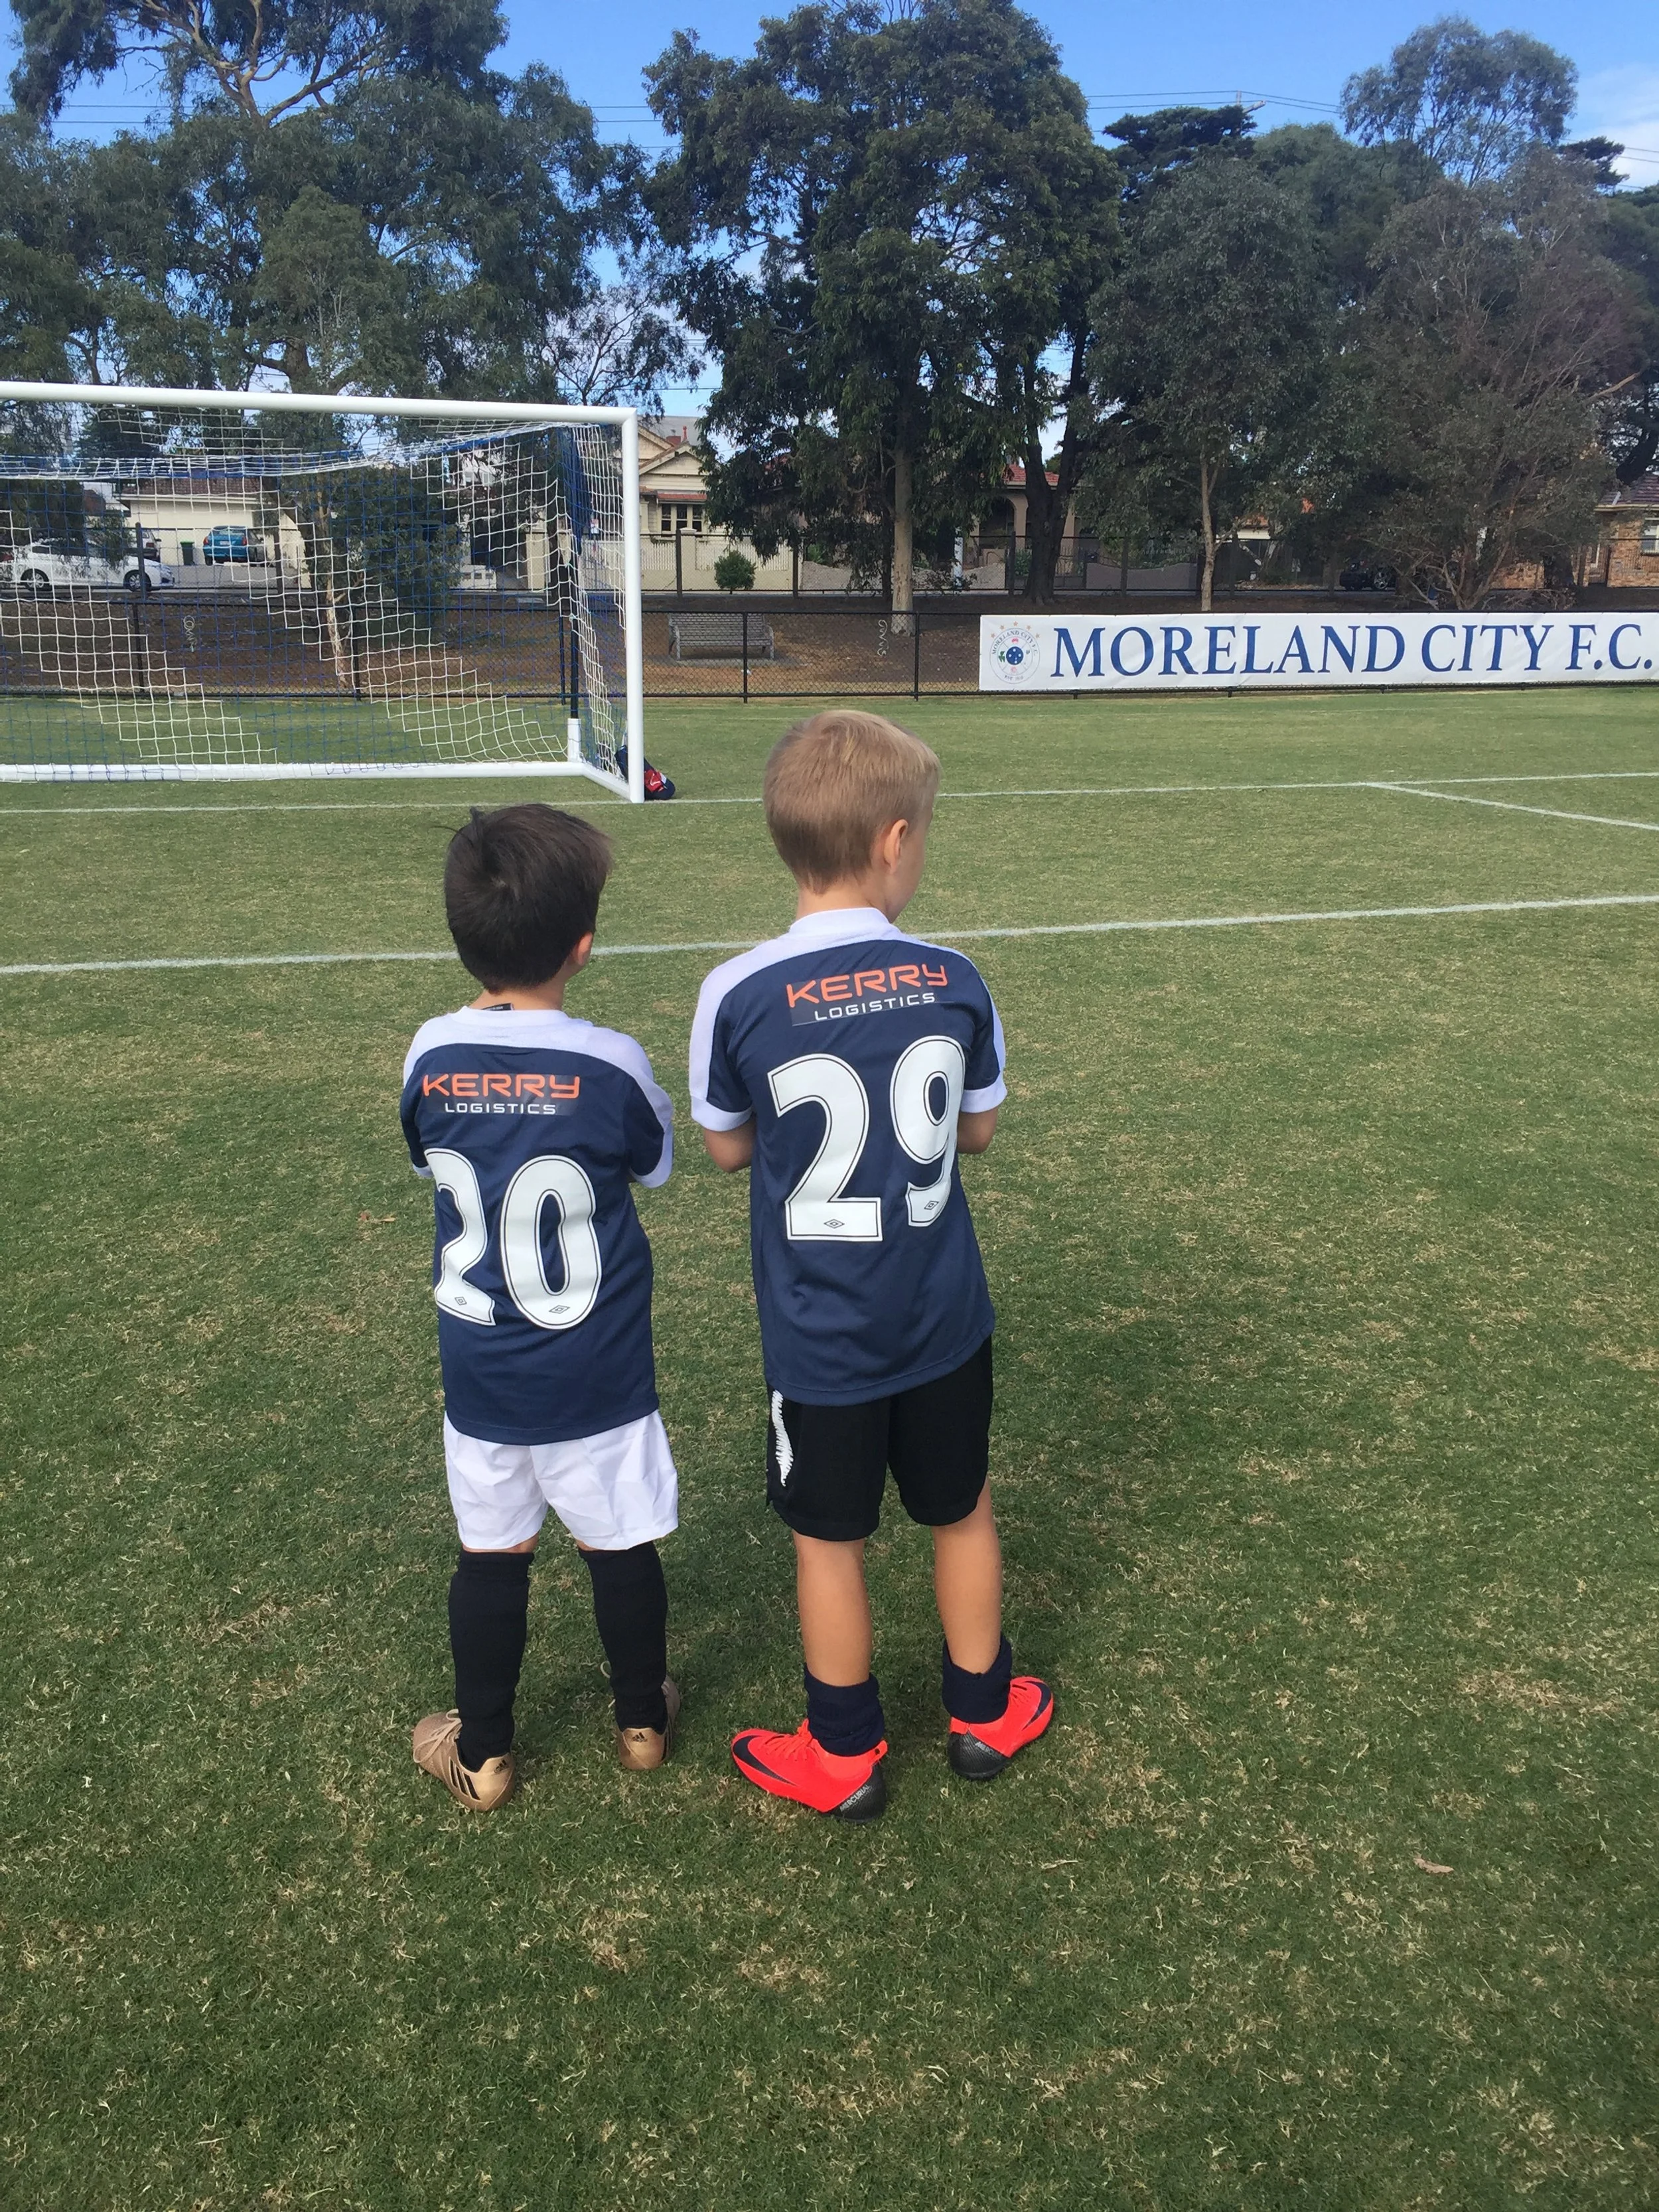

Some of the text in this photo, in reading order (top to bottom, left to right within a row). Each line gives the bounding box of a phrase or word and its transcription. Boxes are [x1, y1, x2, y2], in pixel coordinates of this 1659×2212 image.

[992, 630, 1019, 654] MORELAND
[1021, 631, 1033, 644] CITY
[1050, 624, 1652, 677] MORELAND CITY F.C.
[786, 964, 948, 1007] KERRY
[814, 992, 935, 1021] LOGISTICS
[423, 1073, 580, 1098] KERRY
[445, 1102, 556, 1115] LOGISTICS
[767, 1035, 966, 1242] 29
[424, 1148, 602, 1329] 20
